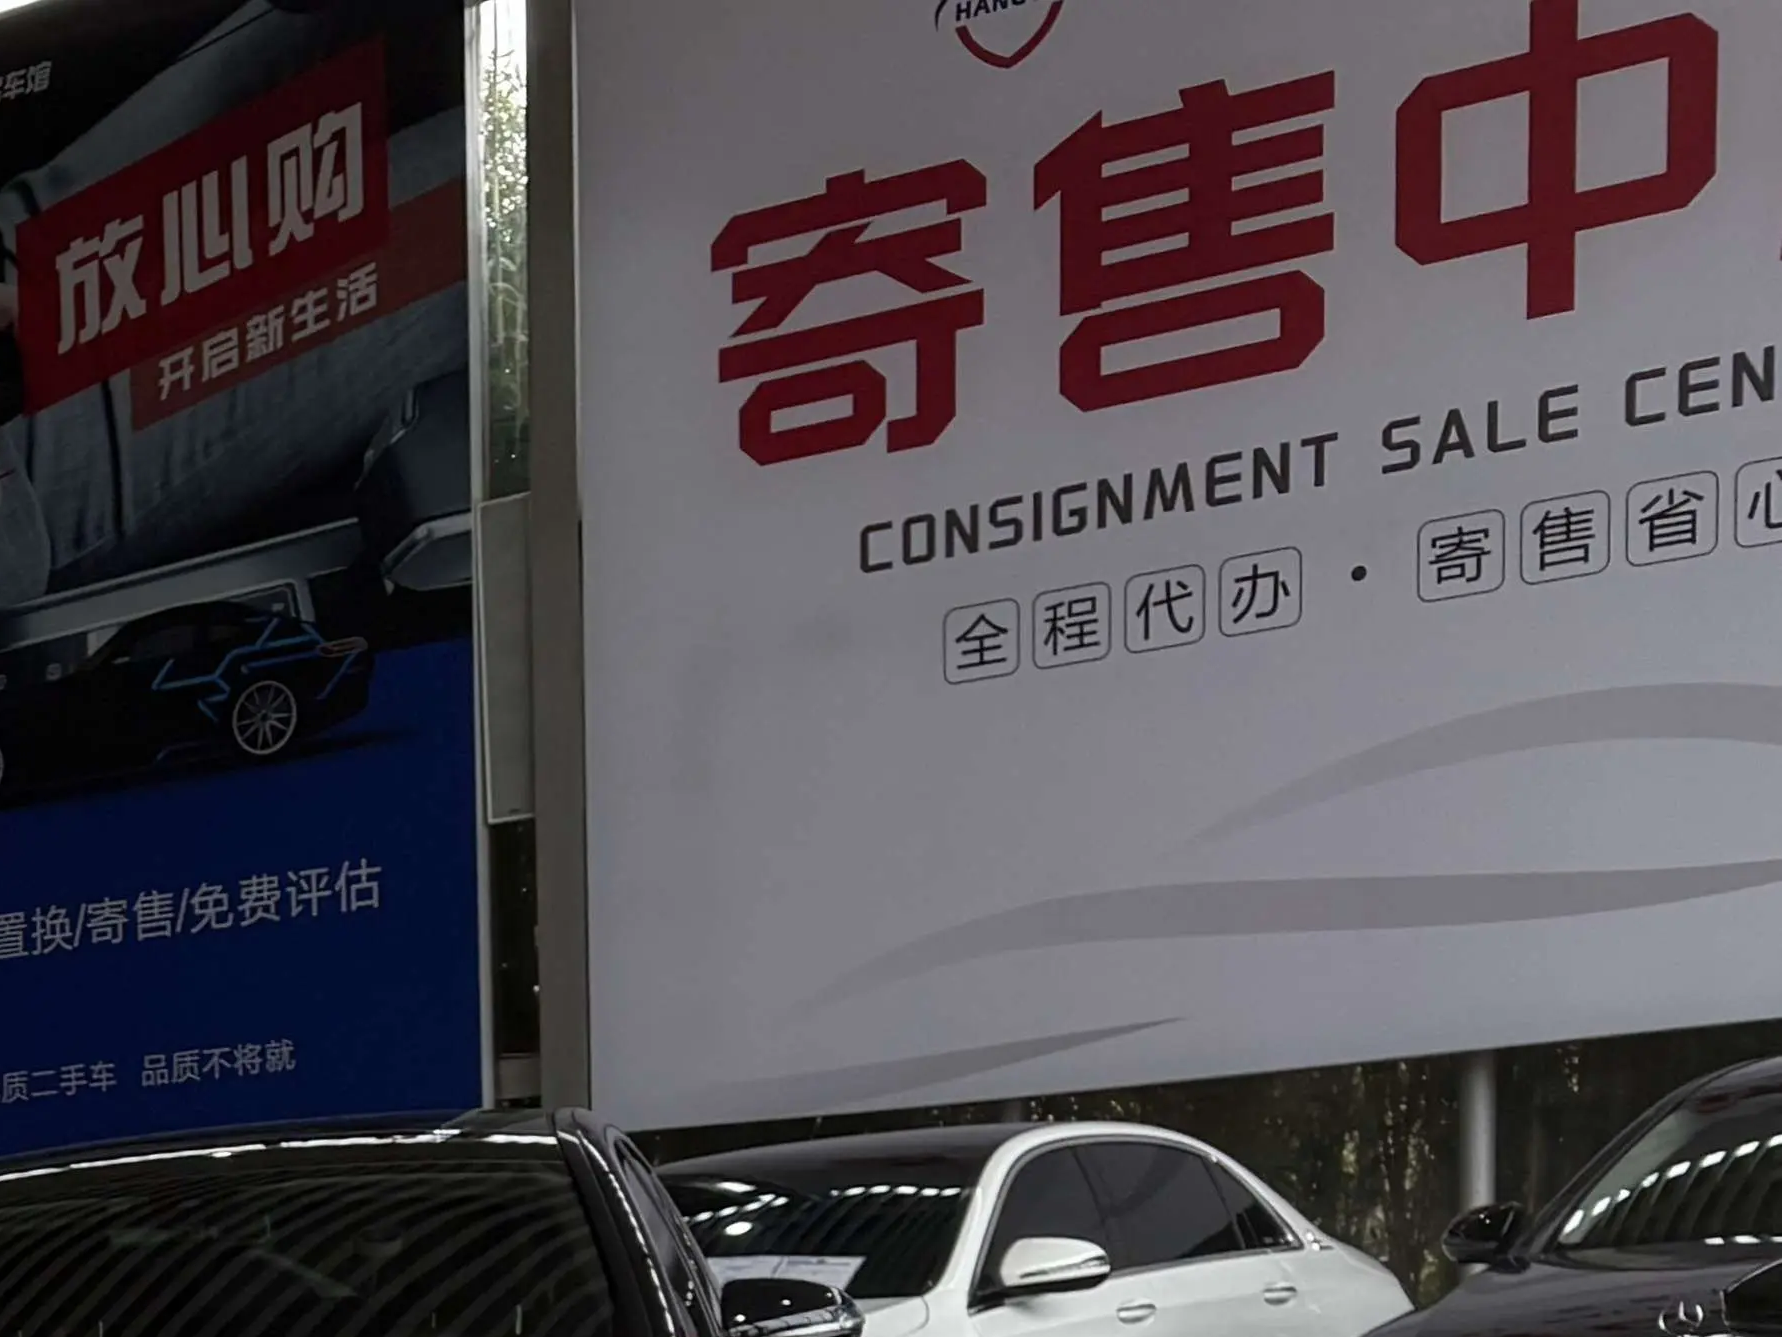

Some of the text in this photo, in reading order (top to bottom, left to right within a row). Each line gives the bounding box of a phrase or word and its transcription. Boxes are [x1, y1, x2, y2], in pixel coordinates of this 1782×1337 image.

[55, 101, 365, 355] 放心购
[157, 262, 378, 401] 开启新生活
[709, 0, 1782, 467] 寄售中
[858, 345, 1776, 573] CONSIGNMENT SALE CEN
[141, 1039, 296, 1087] 品质不将就
